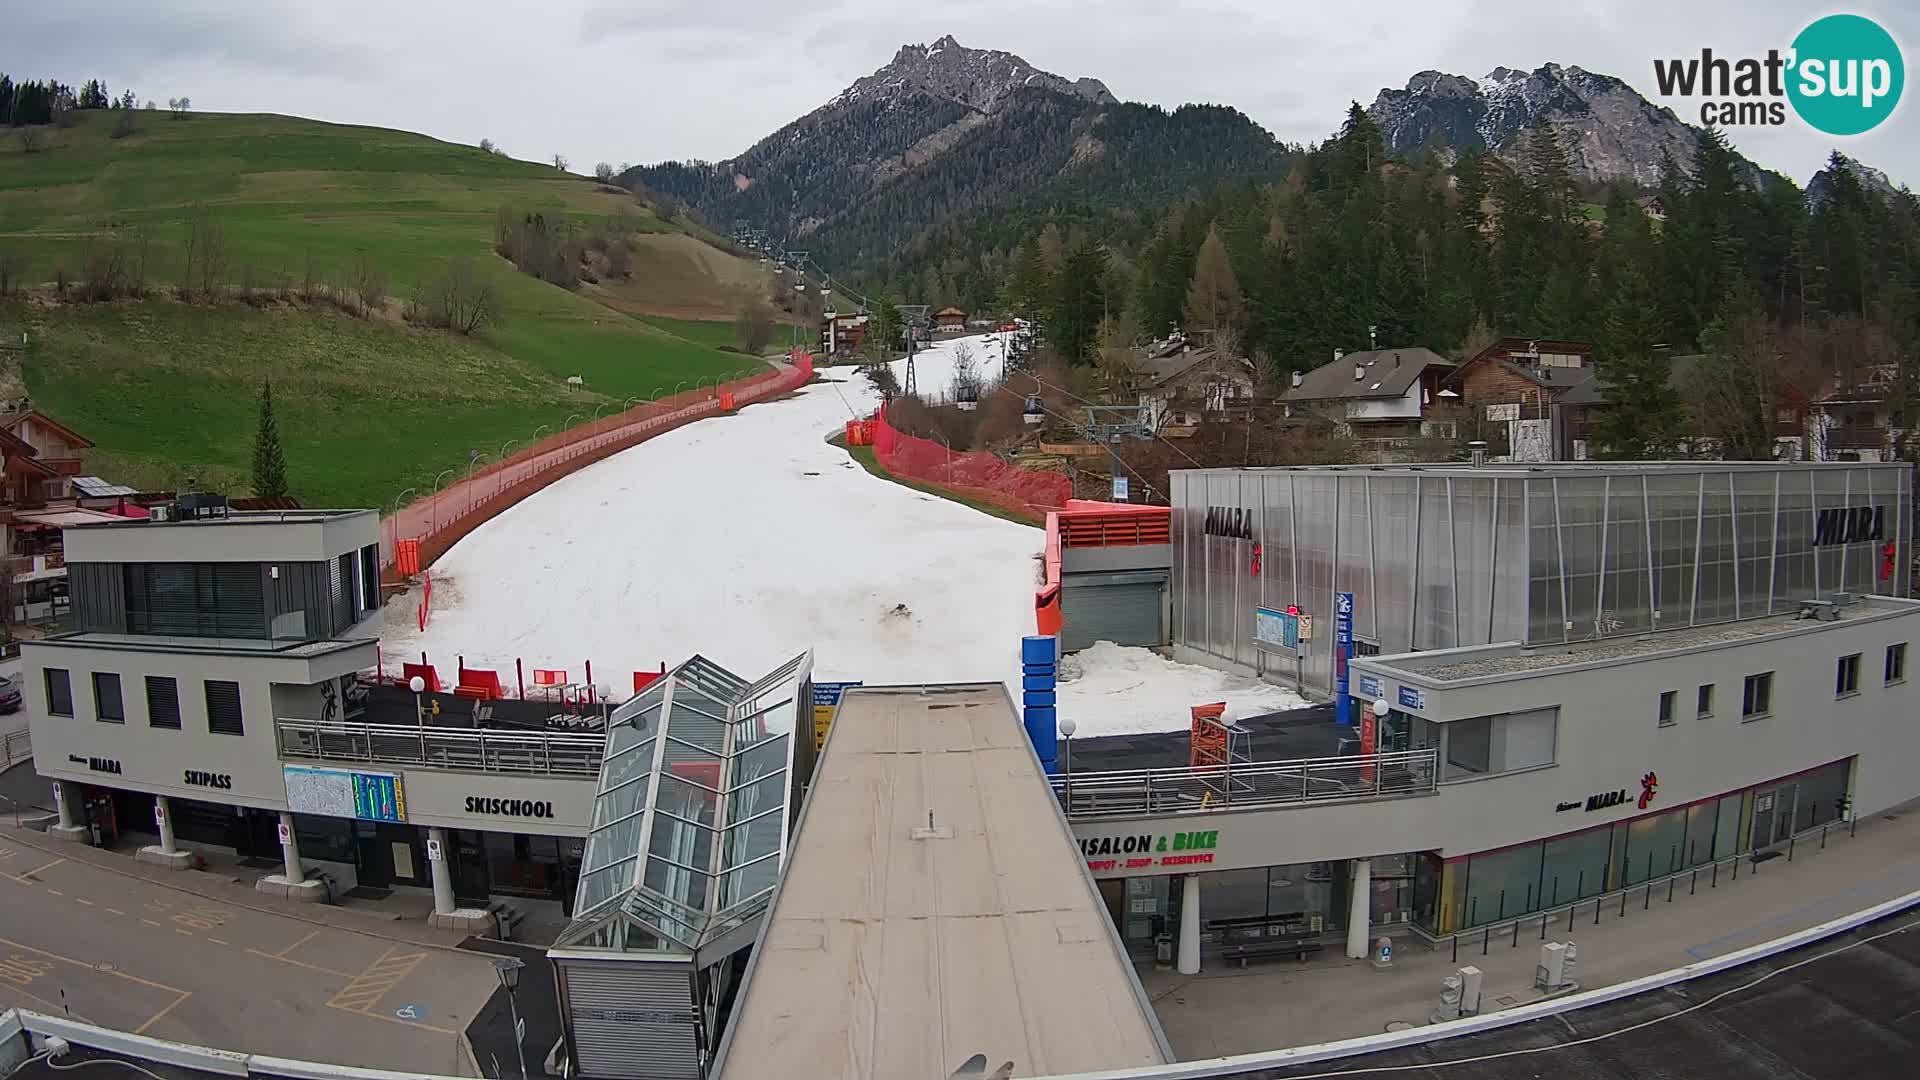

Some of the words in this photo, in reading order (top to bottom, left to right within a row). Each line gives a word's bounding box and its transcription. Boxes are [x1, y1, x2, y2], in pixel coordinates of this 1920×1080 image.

[1205, 506, 1252, 539] MIARA
[1813, 505, 1883, 546] MIARA
[90, 757, 122, 775] MIARA
[184, 770, 231, 789] SKIPASS
[465, 796, 554, 819] SKISCHOOL
[1585, 789, 1625, 812] MIARA
[1156, 836, 1168, 851] &
[1173, 830, 1218, 850] BIKE
